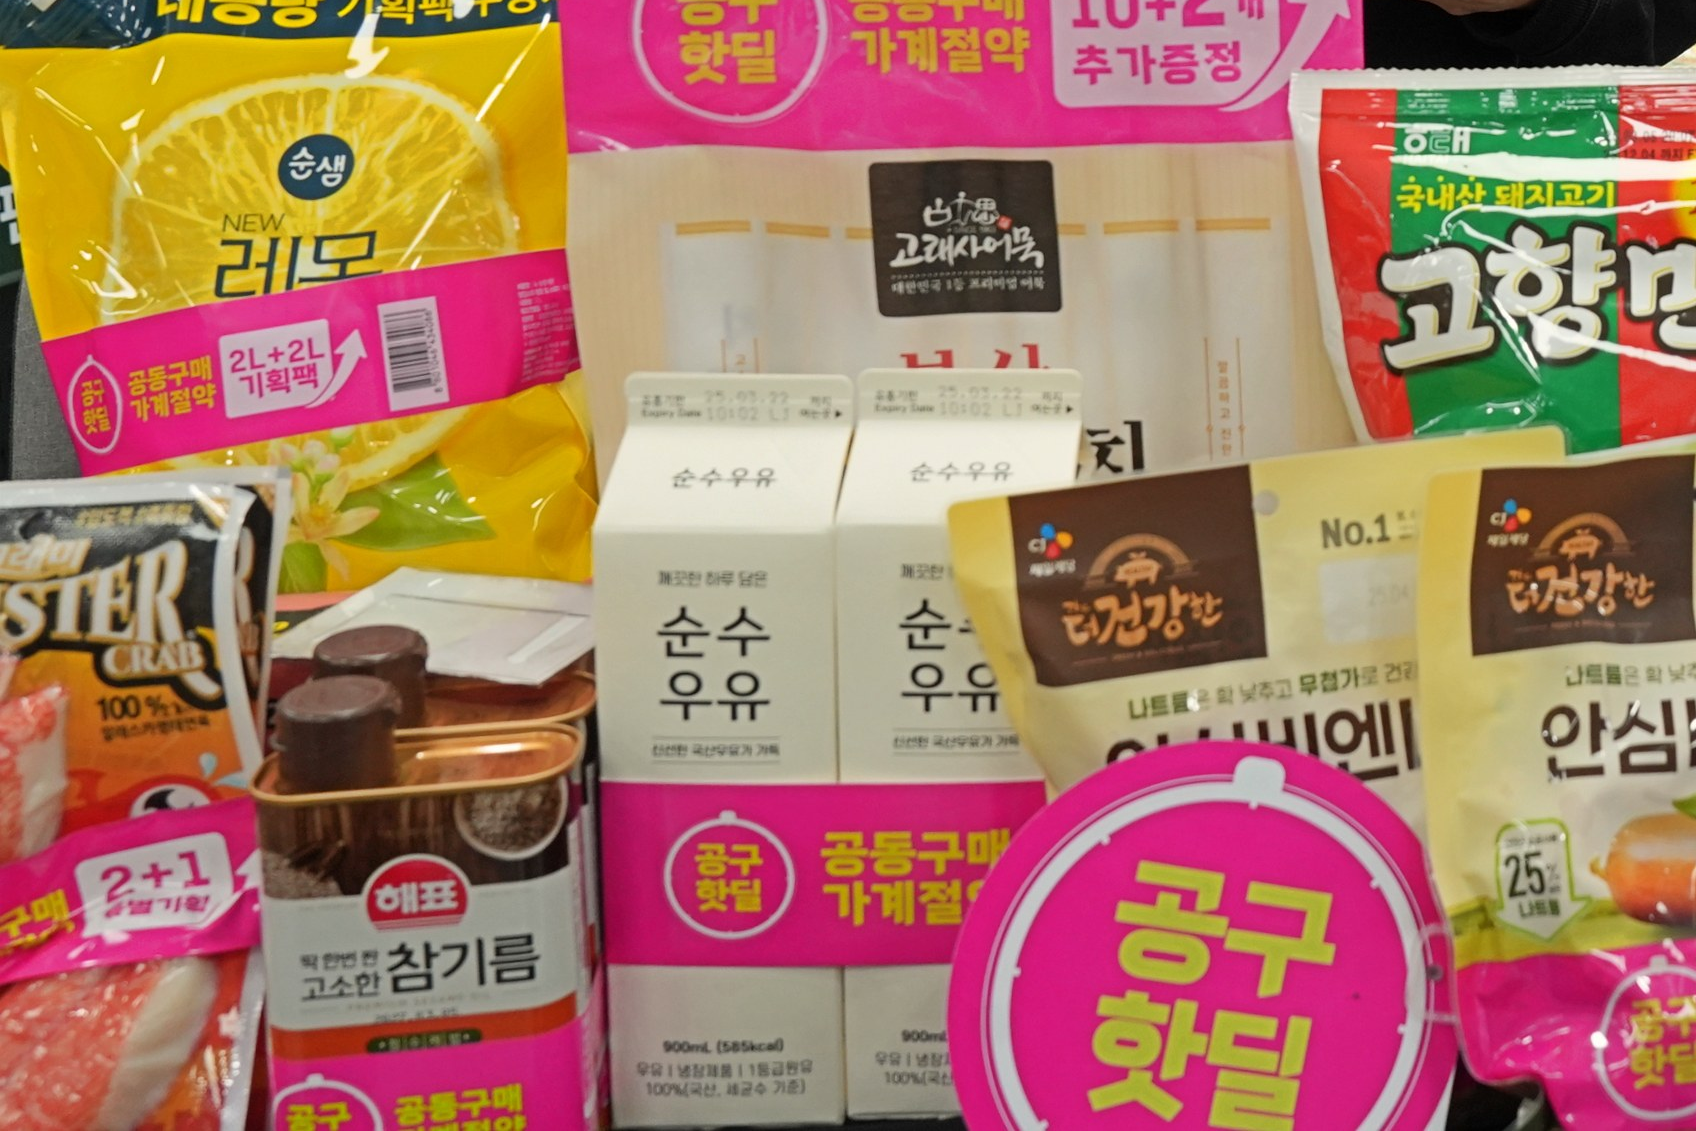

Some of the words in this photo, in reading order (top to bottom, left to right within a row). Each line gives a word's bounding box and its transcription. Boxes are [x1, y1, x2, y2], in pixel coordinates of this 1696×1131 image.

[678, 31, 778, 86] 핫딜
[851, 27, 1030, 76] 가계절약
[1072, 42, 1243, 88] 추가증정
[1396, 177, 1488, 214] 국내산
[1494, 179, 1616, 210] 돼지고기
[222, 212, 286, 232] NEW
[889, 226, 1045, 269] 고래사어묵
[80, 377, 105, 406] 공구
[128, 355, 213, 395] 공동구매
[672, 466, 777, 489] 순수우유
[910, 461, 1014, 485] 순수우유
[1320, 516, 1391, 550] No.1
[656, 605, 772, 658] 순수
[102, 640, 205, 675] CRAB
[659, 670, 772, 722] 우유
[694, 843, 764, 876] 공구
[373, 876, 461, 917] 해표
[694, 878, 763, 913] 핫딜
[1112, 859, 1337, 1000] 공구
[301, 970, 382, 1002] 고소한
[385, 932, 541, 994] 참기름
[1086, 988, 1314, 1131] 핫딜
